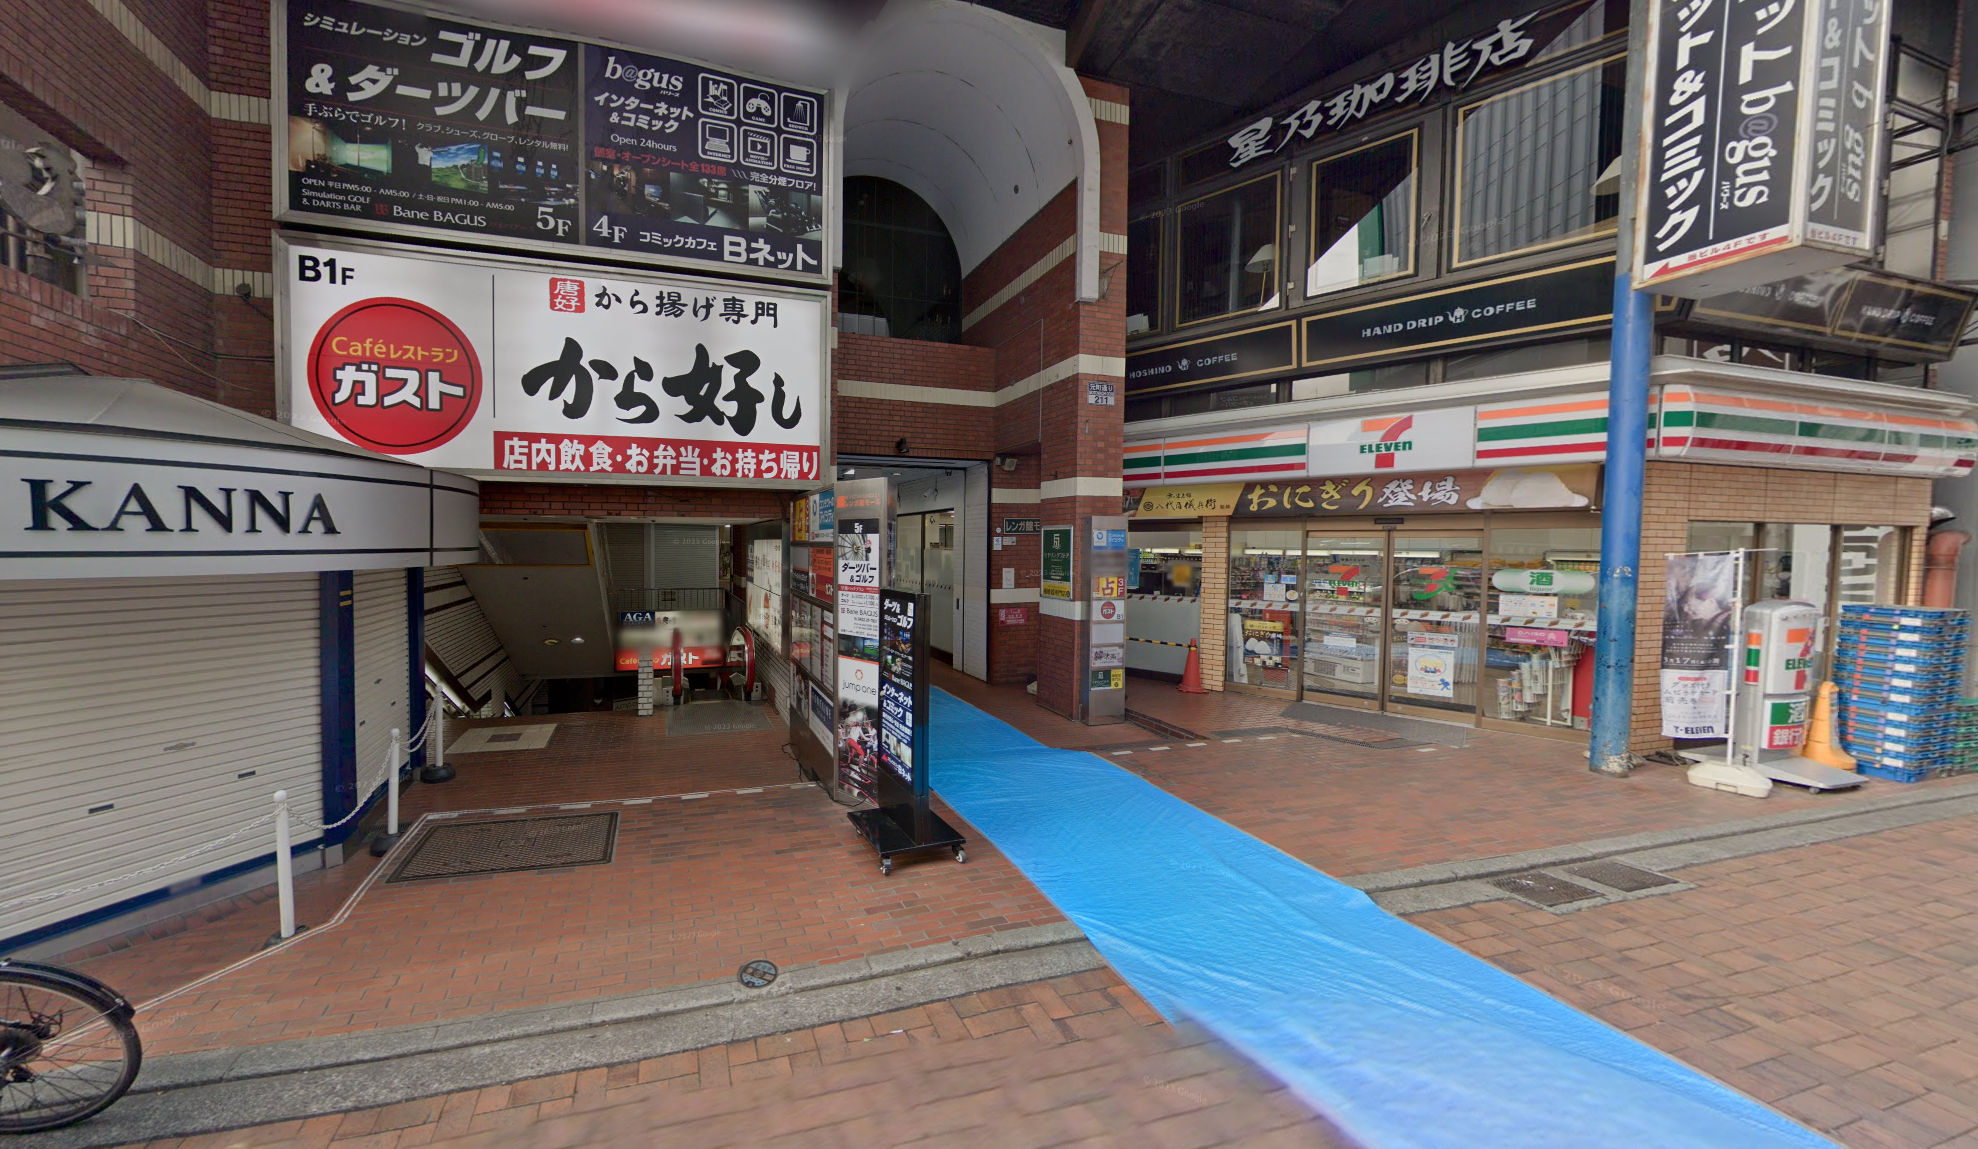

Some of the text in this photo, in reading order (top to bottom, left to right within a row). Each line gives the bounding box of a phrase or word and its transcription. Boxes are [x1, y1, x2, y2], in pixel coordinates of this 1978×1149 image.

[303, 13, 568, 80] シミュレーション ゴルフ
[1739, 0, 1795, 86] ット
[604, 56, 683, 92] b@gus
[305, 63, 567, 124] & ダーツバー
[1228, 10, 1541, 168] 星乃珈琲店
[594, 91, 694, 121] インターネット
[609, 111, 680, 133] &コミック
[788, 123, 809, 131] SHOWER
[1655, 0, 1715, 253] ット&コミック
[611, 133, 677, 152] Open 24hours
[707, 151, 731, 159] INTERNET
[745, 157, 773, 166] ANIMATION
[301, 177, 325, 188] OPEN
[342, 181, 372, 193] PM5:00
[378, 185, 410, 198] AM5:00
[450, 196, 478, 207] PM1:00
[485, 201, 515, 212] AM5:00
[301, 188, 371, 204] Simulation GOLF
[312, 199, 342, 211] DARTS
[343, 203, 362, 212] BAR
[393, 205, 487, 228] Bane BAGUS
[536, 206, 571, 237] 5F
[592, 215, 627, 243] 4F
[639, 231, 818, 271] コミックカフェ Bネット
[298, 254, 355, 285] B1F
[594, 285, 778, 328] から揚げ専門
[1362, 299, 1537, 338] HAND DRIP COFFEE
[1129, 352, 1238, 379] HOSHINO COFFEE
[332, 361, 467, 412] ガスト
[521, 336, 802, 436] から好し
[1094, 396, 1108, 404] 211
[502, 437, 818, 480] 店内飲食・お弁当・お持ち帰り
[1360, 440, 1412, 454] ELEVEN
[20, 477, 341, 535] KANNA
[854, 523, 863, 533] 5F
[842, 562, 877, 573] ダーツバー
[849, 575, 875, 583] &ゴルフ
[1529, 572, 1554, 586] 酒
[624, 612, 652, 622] AGA
[842, 680, 876, 695] jump one
